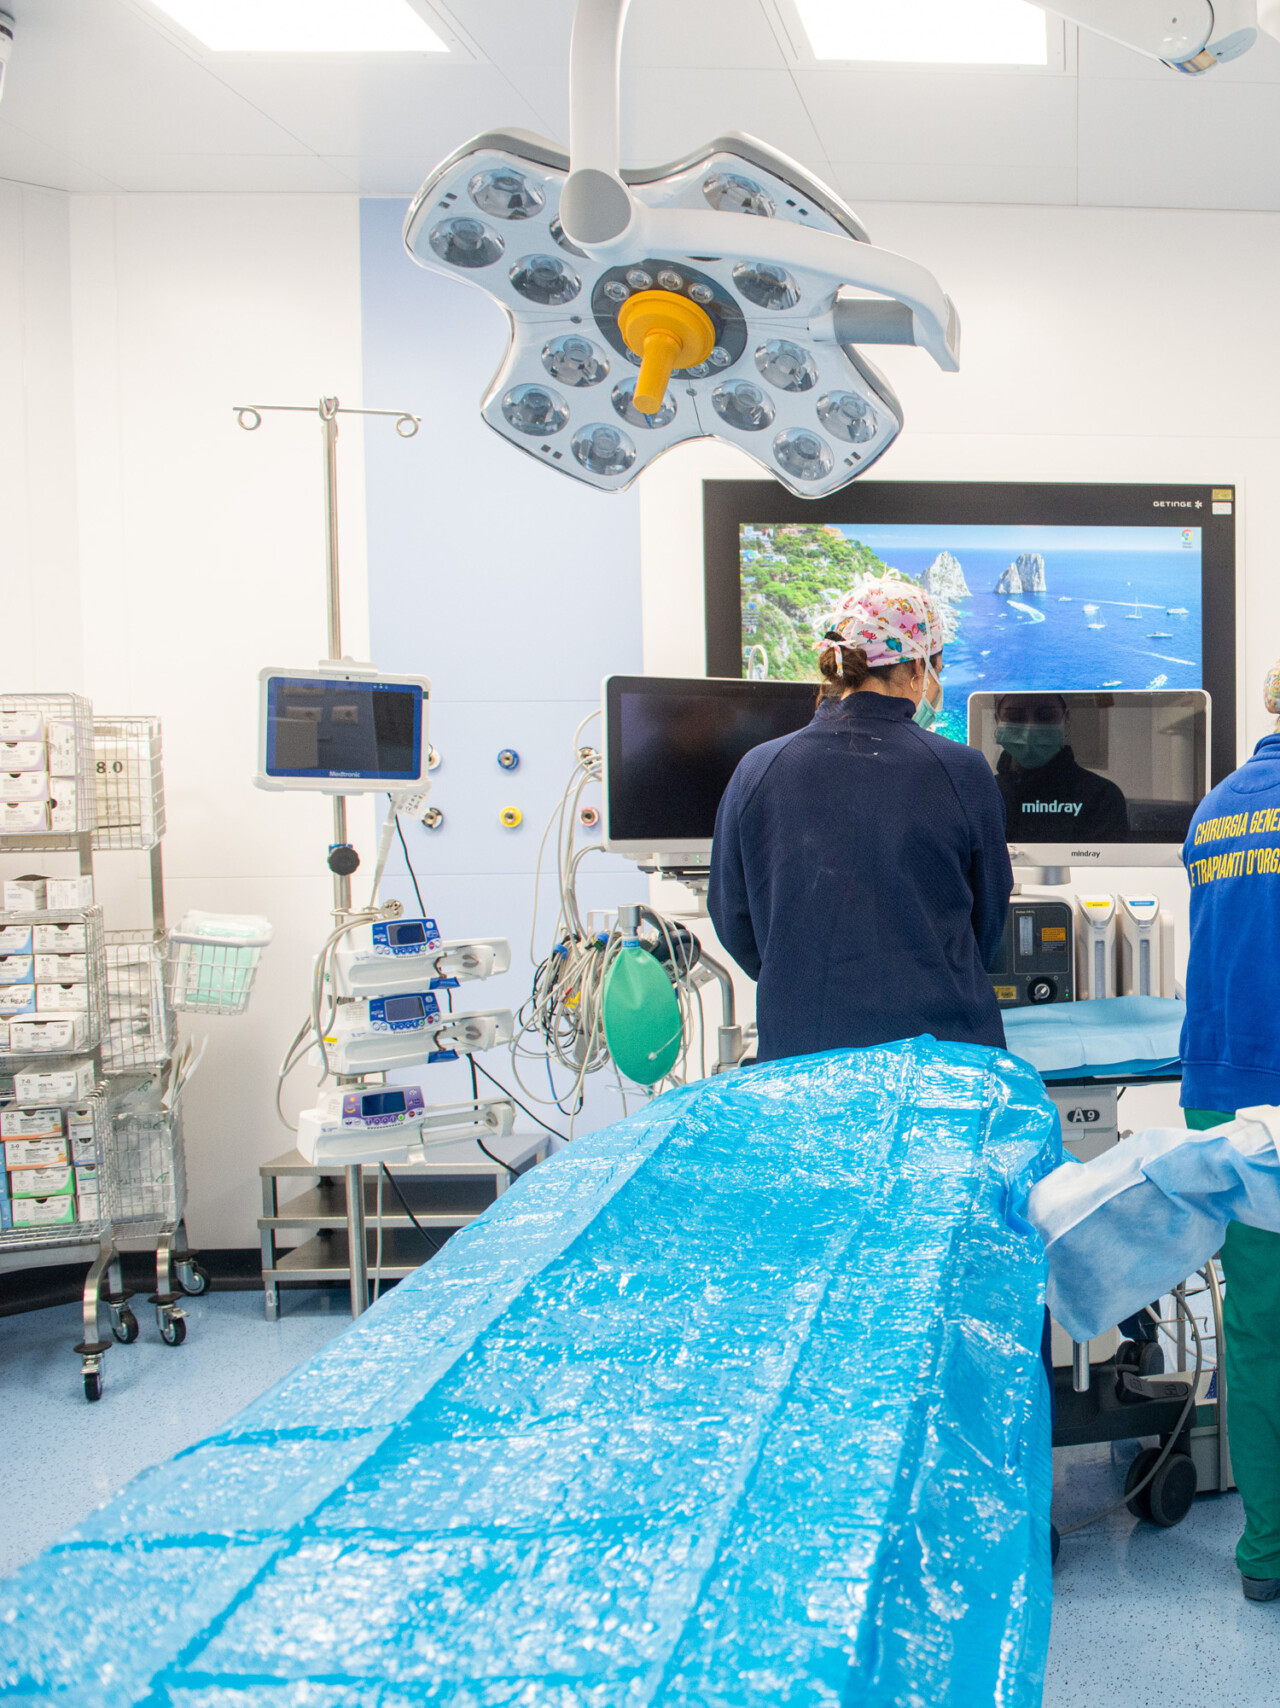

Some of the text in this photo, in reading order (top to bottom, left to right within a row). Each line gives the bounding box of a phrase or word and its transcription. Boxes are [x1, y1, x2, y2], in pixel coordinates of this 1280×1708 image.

[328, 770, 361, 779] Medtronic
[1021, 800, 1083, 817] mindray
[1194, 811, 1249, 846] CHIRURGIA
[1071, 850, 1101, 859] mindray
[1195, 850, 1246, 886] TRAPIANTI
